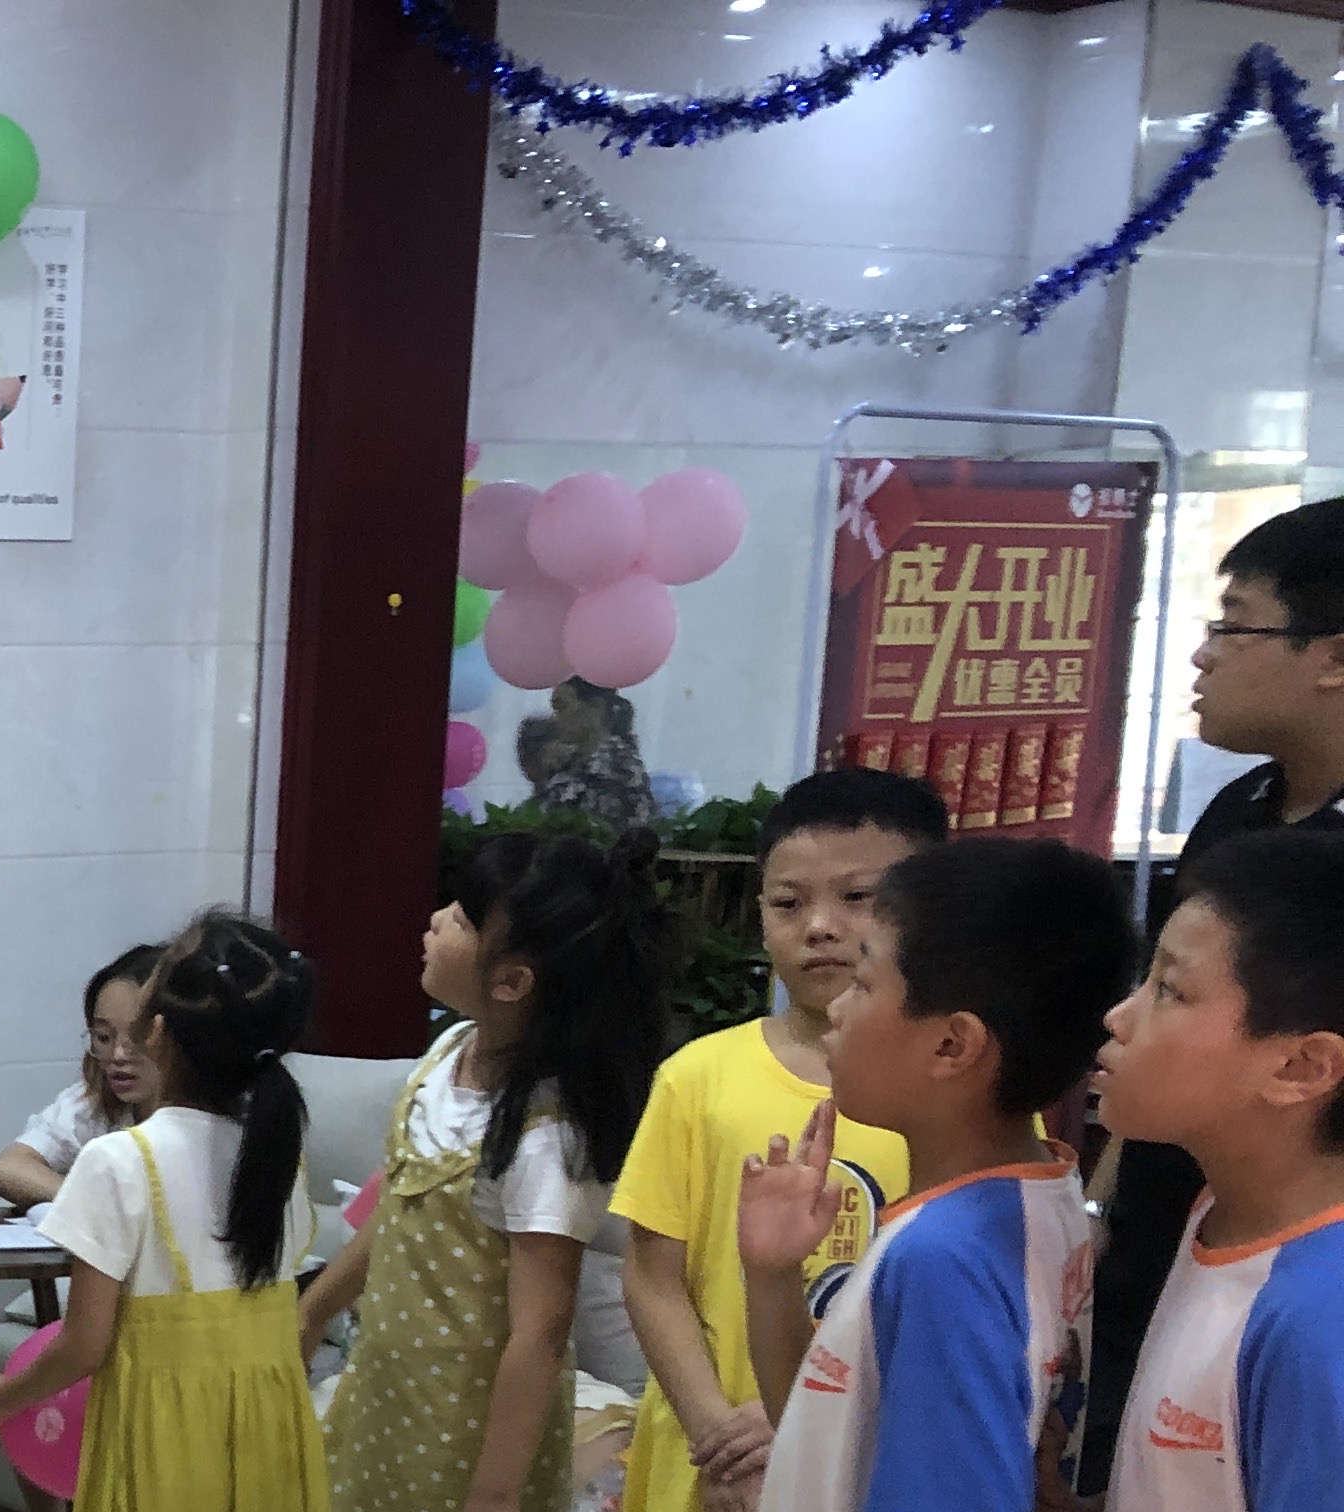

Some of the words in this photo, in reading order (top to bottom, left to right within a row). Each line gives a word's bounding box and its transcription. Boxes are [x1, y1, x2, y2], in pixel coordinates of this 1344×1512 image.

[11, 492, 60, 505] qualities
[875, 542, 1096, 722] 盛大开业
[953, 656, 1085, 707] 优惠全员
